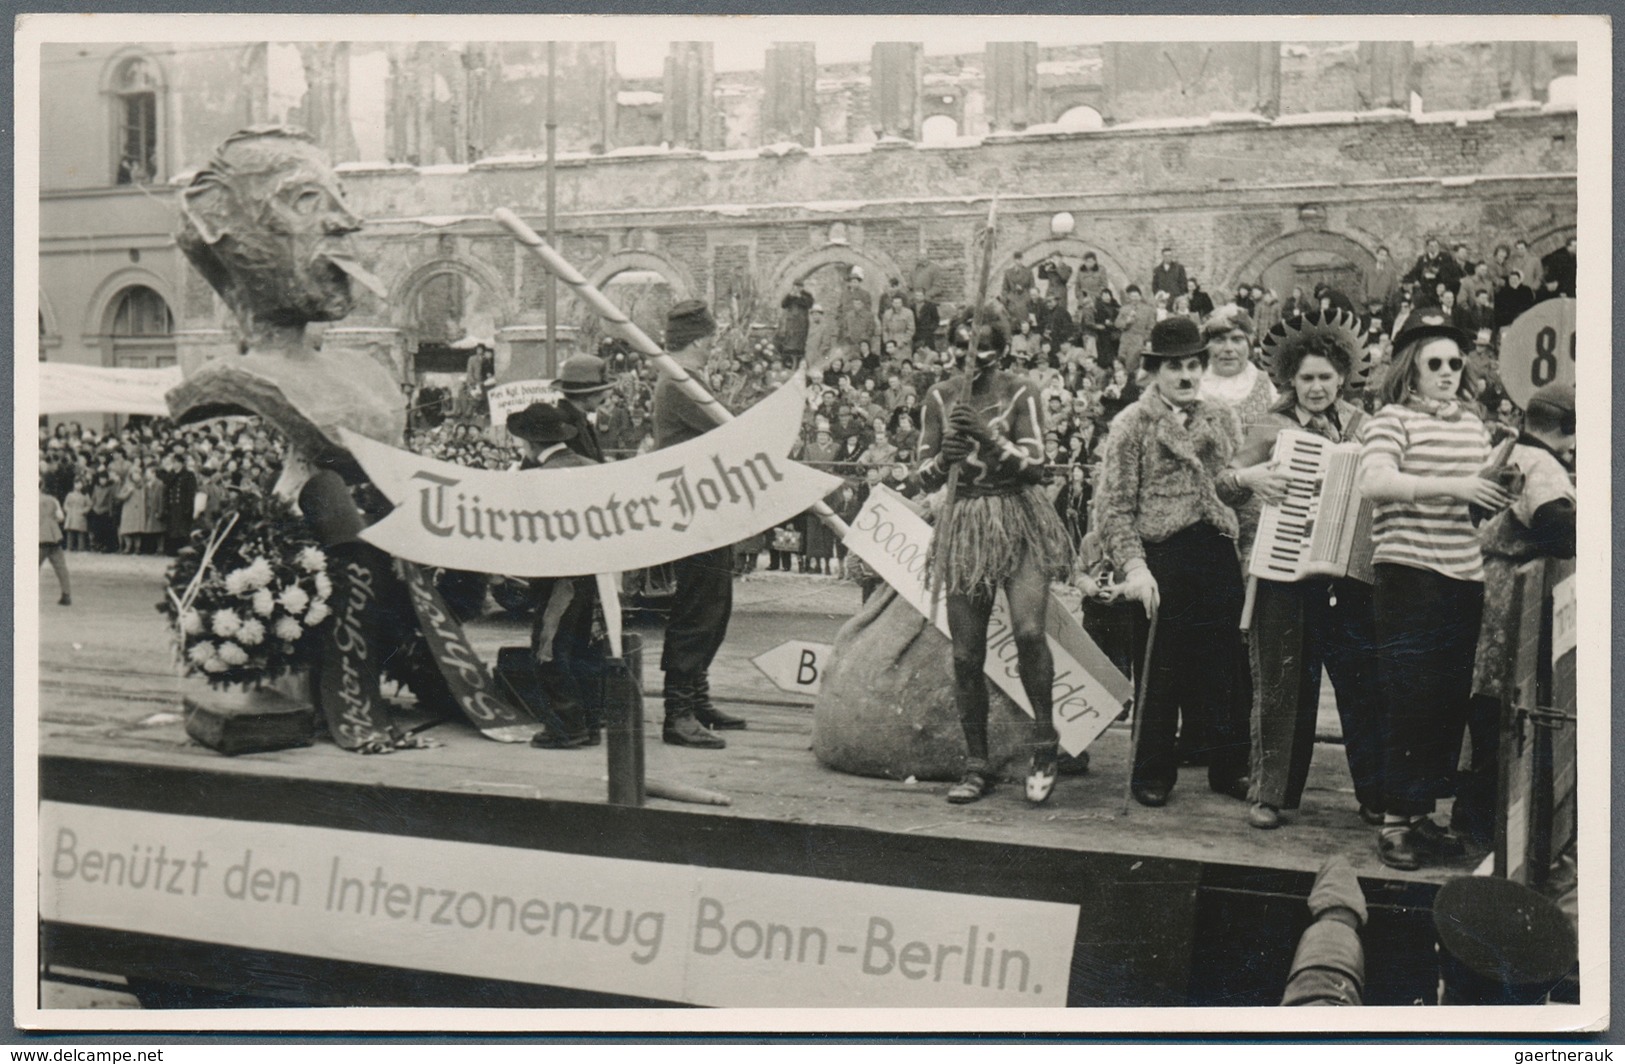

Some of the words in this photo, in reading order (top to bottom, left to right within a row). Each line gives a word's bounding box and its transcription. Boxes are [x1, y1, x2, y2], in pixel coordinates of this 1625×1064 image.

[411, 470, 660, 543] Türmvater
[656, 451, 783, 532] John
[334, 563, 375, 660] Gruß
[796, 648, 818, 686] B
[51, 827, 208, 896] Benützt
[223, 849, 300, 906] den
[325, 855, 665, 965] Interzonenzug
